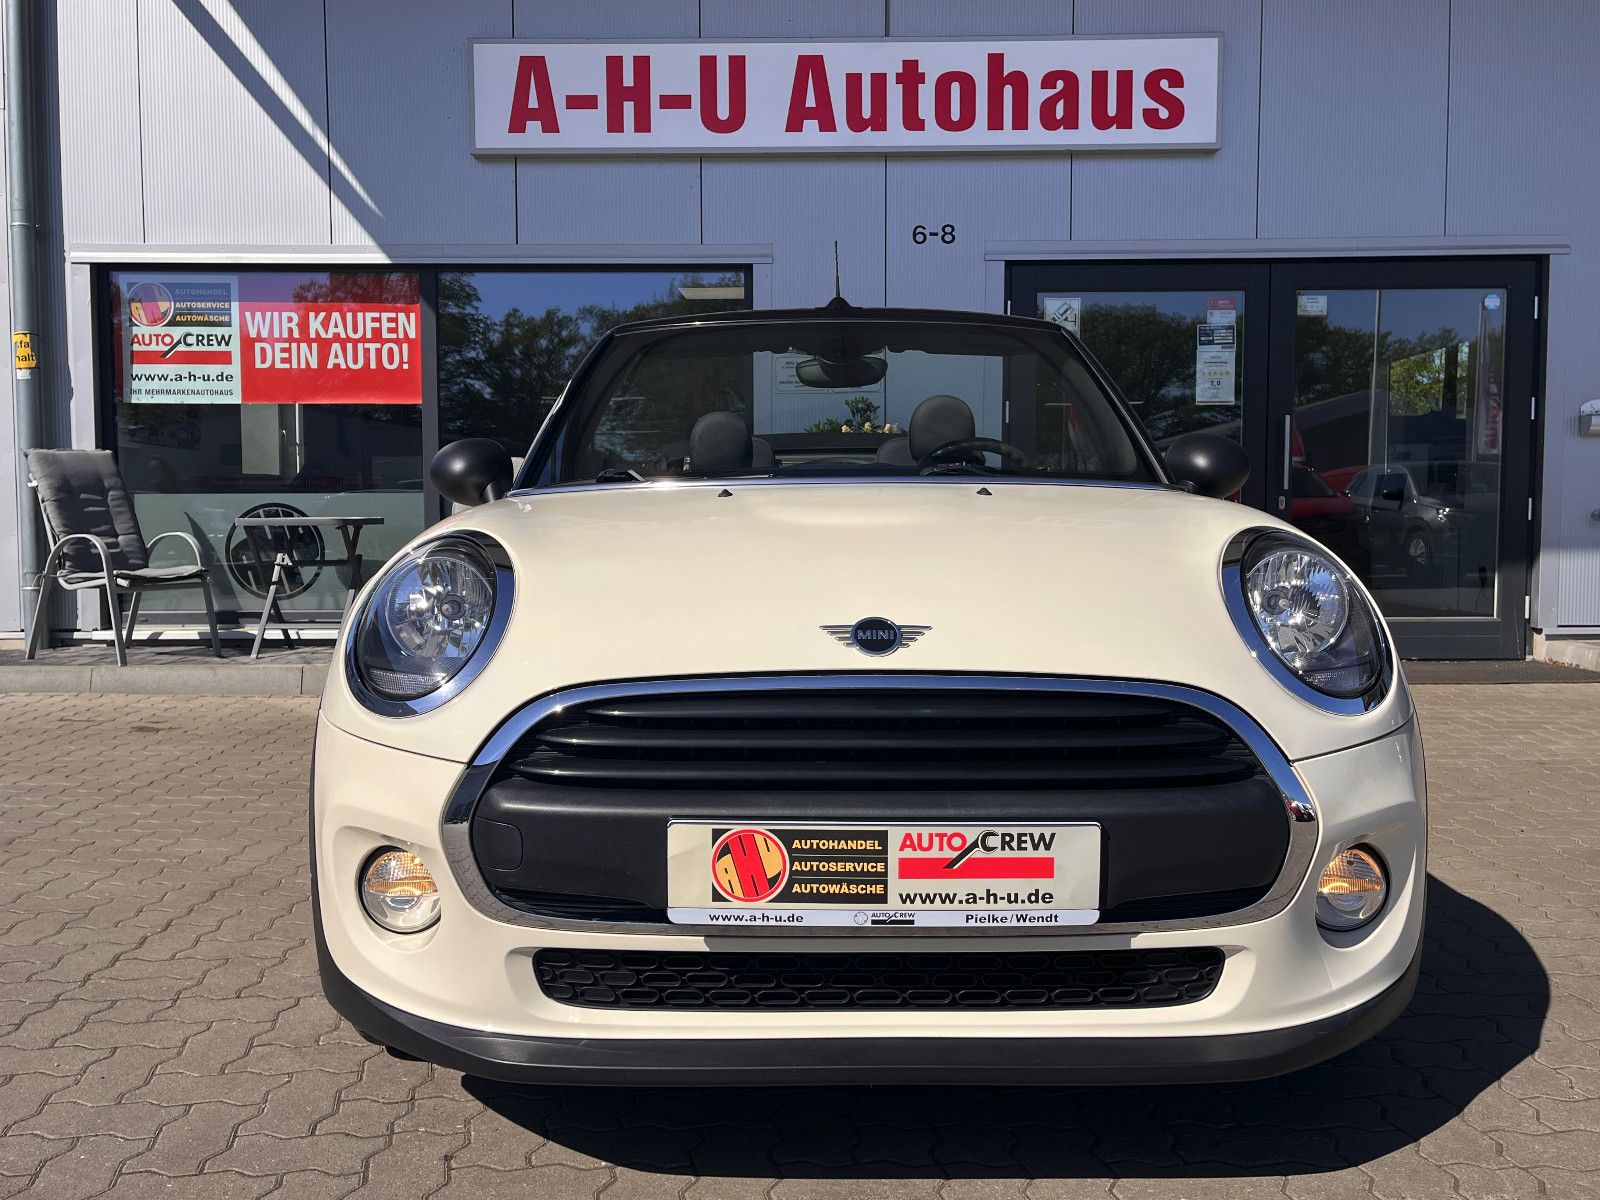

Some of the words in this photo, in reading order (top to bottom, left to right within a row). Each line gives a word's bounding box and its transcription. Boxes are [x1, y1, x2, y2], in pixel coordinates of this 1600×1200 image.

[507, 55, 747, 135] A-H-U
[784, 53, 1186, 134] Autohaus
[911, 224, 957, 245] 6-8
[244, 311, 300, 339] WIR
[308, 311, 416, 339] KAUFEN
[131, 333, 174, 347] AUTO
[182, 332, 232, 347] CREW
[254, 342, 318, 369] DEIN
[326, 342, 410, 370] AUTO!
[130, 372, 233, 382] www.a-h-u.de
[144, 388, 233, 396] MEHRMARKENAUTOHAUS
[857, 629, 894, 640] MINI
[792, 839, 882, 850] AUTOHANDEL
[899, 832, 967, 852] AUTO
[978, 830, 1056, 853] CREW
[792, 861, 886, 872] AUTOSERVICE
[792, 882, 885, 894] AUTOWÄSCHE
[899, 889, 1054, 905] www.a-h-u.de
[709, 913, 804, 923] www.a-h-u.de
[965, 913, 1059, 924] Pielke/Wendt
